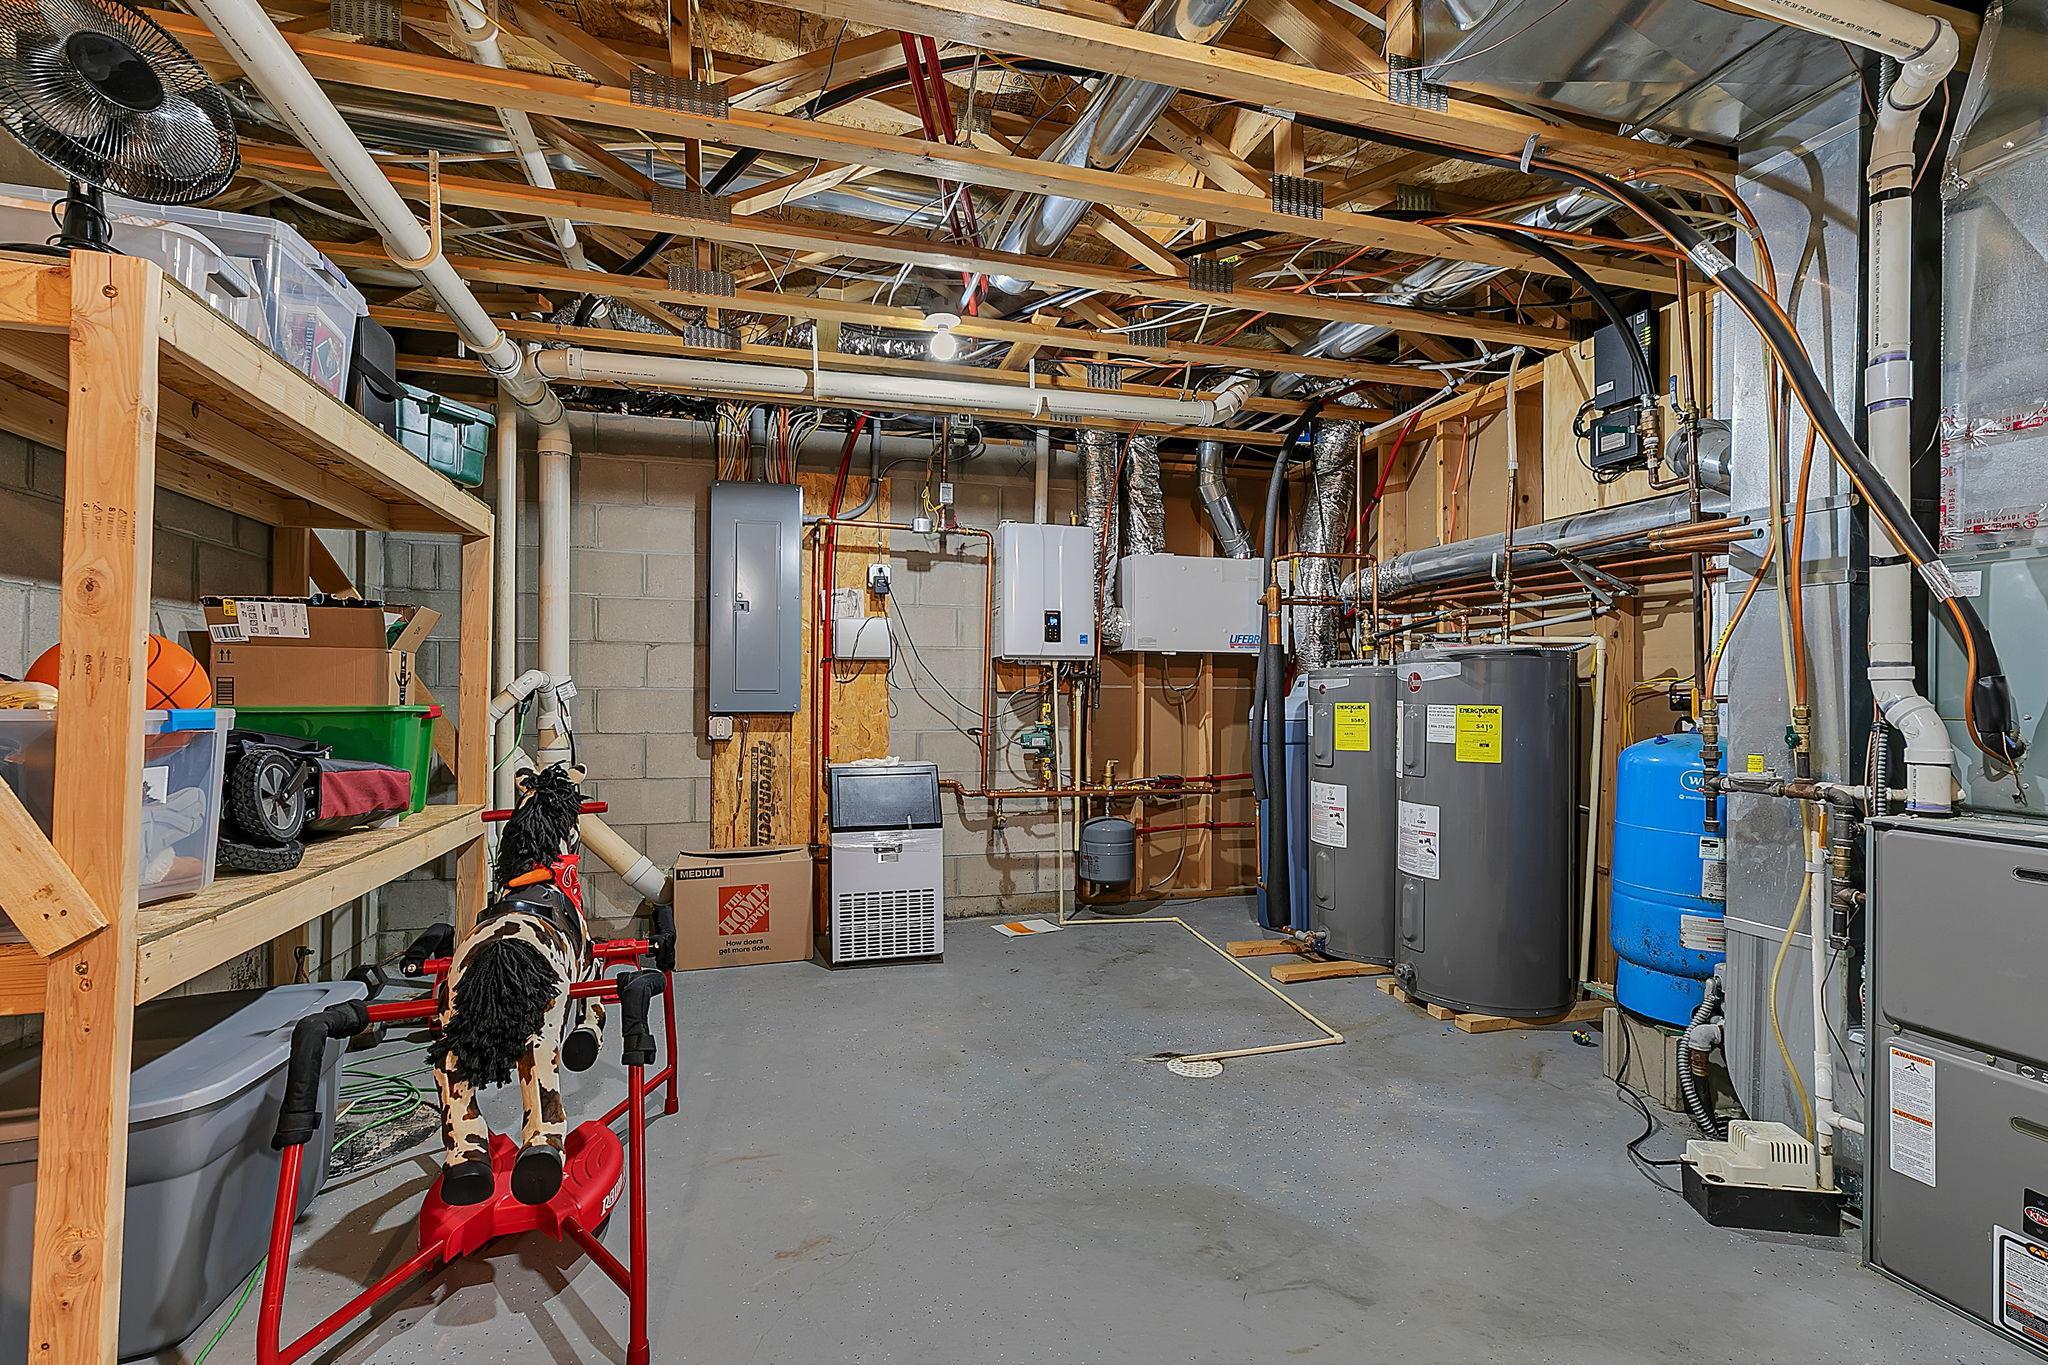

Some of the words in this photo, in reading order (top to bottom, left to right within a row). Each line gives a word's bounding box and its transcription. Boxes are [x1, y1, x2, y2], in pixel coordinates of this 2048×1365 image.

[1230, 634, 1260, 644] LIFEBR
[1460, 707, 1499, 715] ENERGYGUIDE
[680, 869, 720, 878] MEDIUM
[724, 891, 745, 911] THE
[719, 885, 769, 935] HOME
[739, 902, 769, 934] DEPOT
